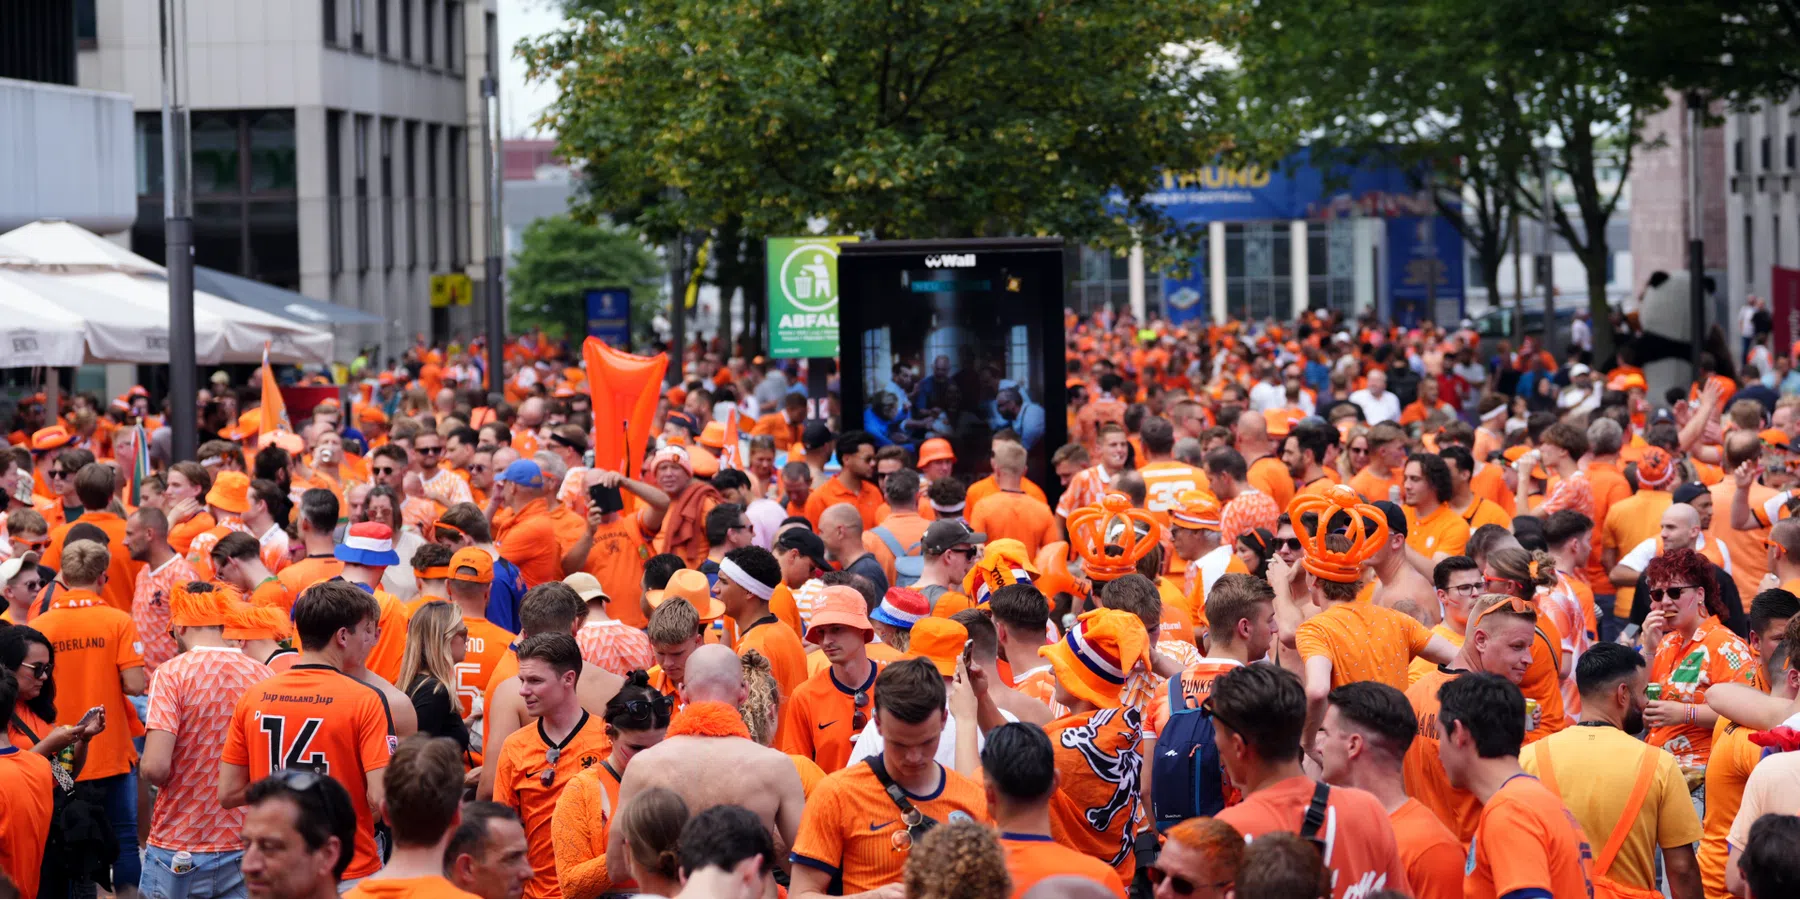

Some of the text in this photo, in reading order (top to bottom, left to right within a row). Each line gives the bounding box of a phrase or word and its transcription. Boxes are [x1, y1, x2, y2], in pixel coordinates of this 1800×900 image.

[941, 253, 977, 268] Wall
[778, 313, 839, 328] ABFAL
[53, 636, 105, 652] EDERLAND
[465, 637, 485, 653] ND
[261, 692, 334, 705] Jup HOLLAND Jup
